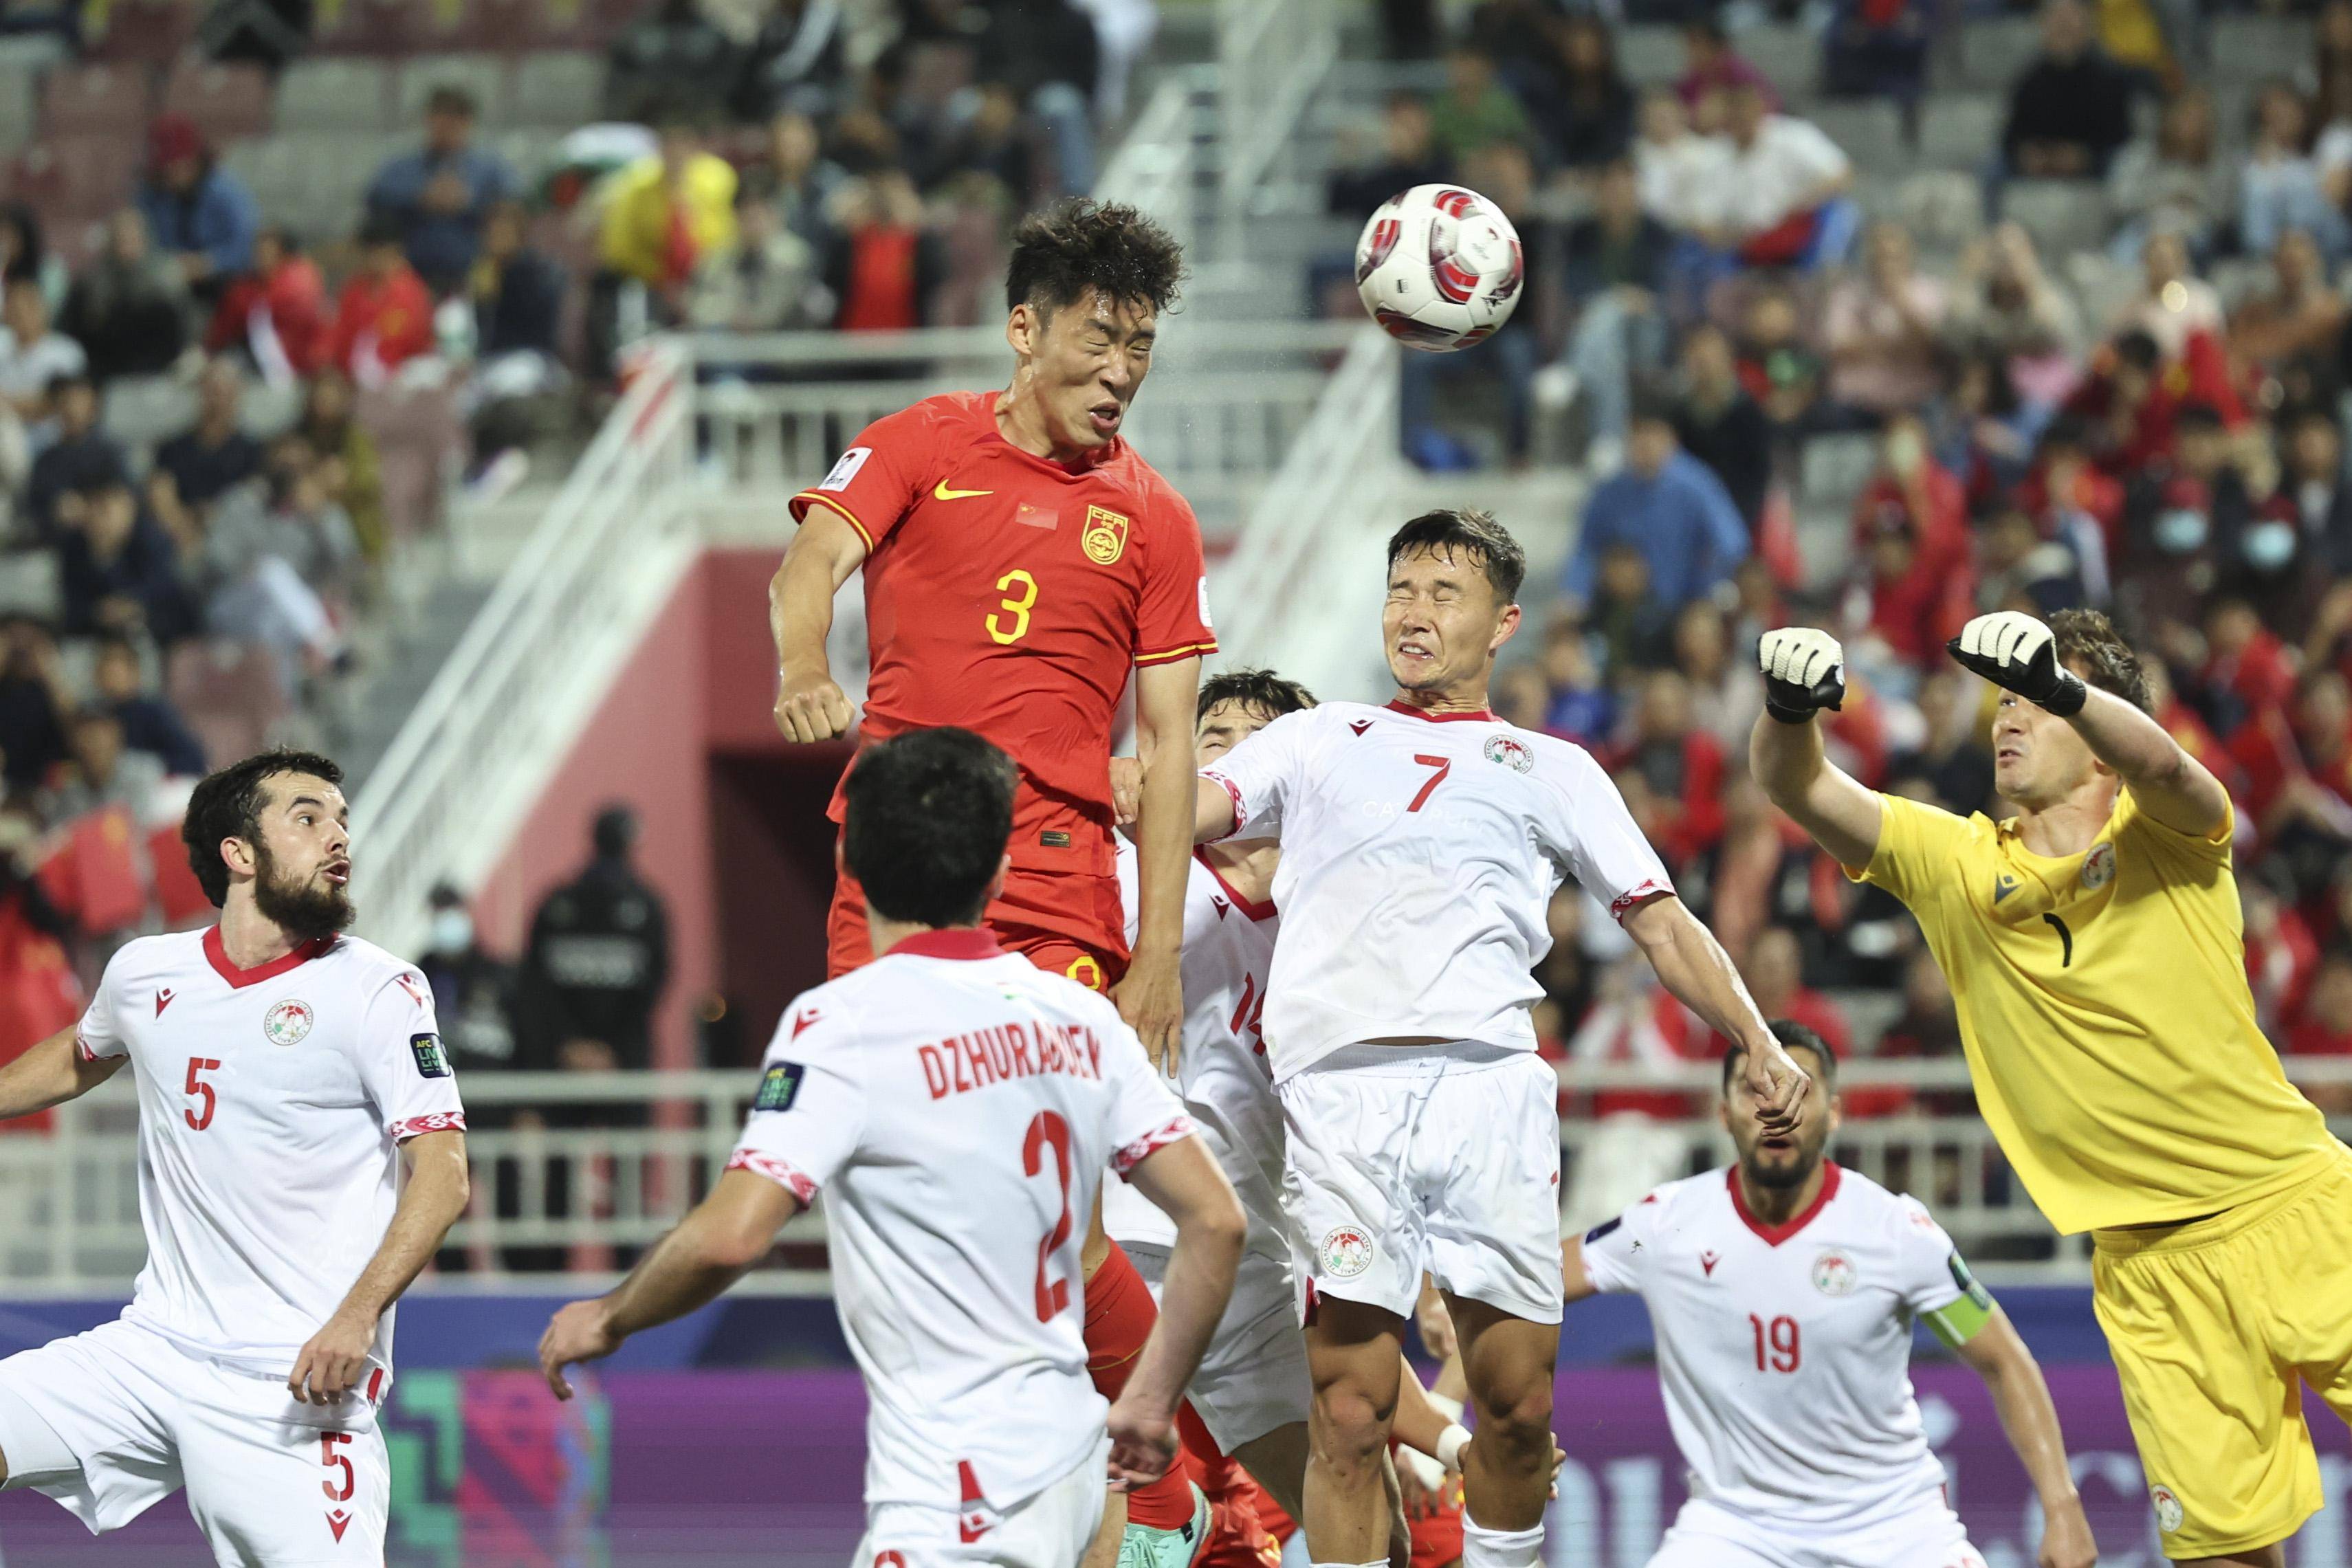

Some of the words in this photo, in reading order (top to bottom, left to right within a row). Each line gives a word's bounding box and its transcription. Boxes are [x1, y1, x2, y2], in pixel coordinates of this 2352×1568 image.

[1091, 509, 1125, 528] CFA
[985, 569, 1039, 645] 3
[1408, 753, 1451, 812] 7
[2042, 912, 2072, 968] 1
[416, 1039, 432, 1048] AFC
[185, 1057, 221, 1131] 5
[1022, 1110, 1073, 1323] 2
[1749, 1314, 1800, 1373] 19
[321, 1432, 355, 1502] 5
